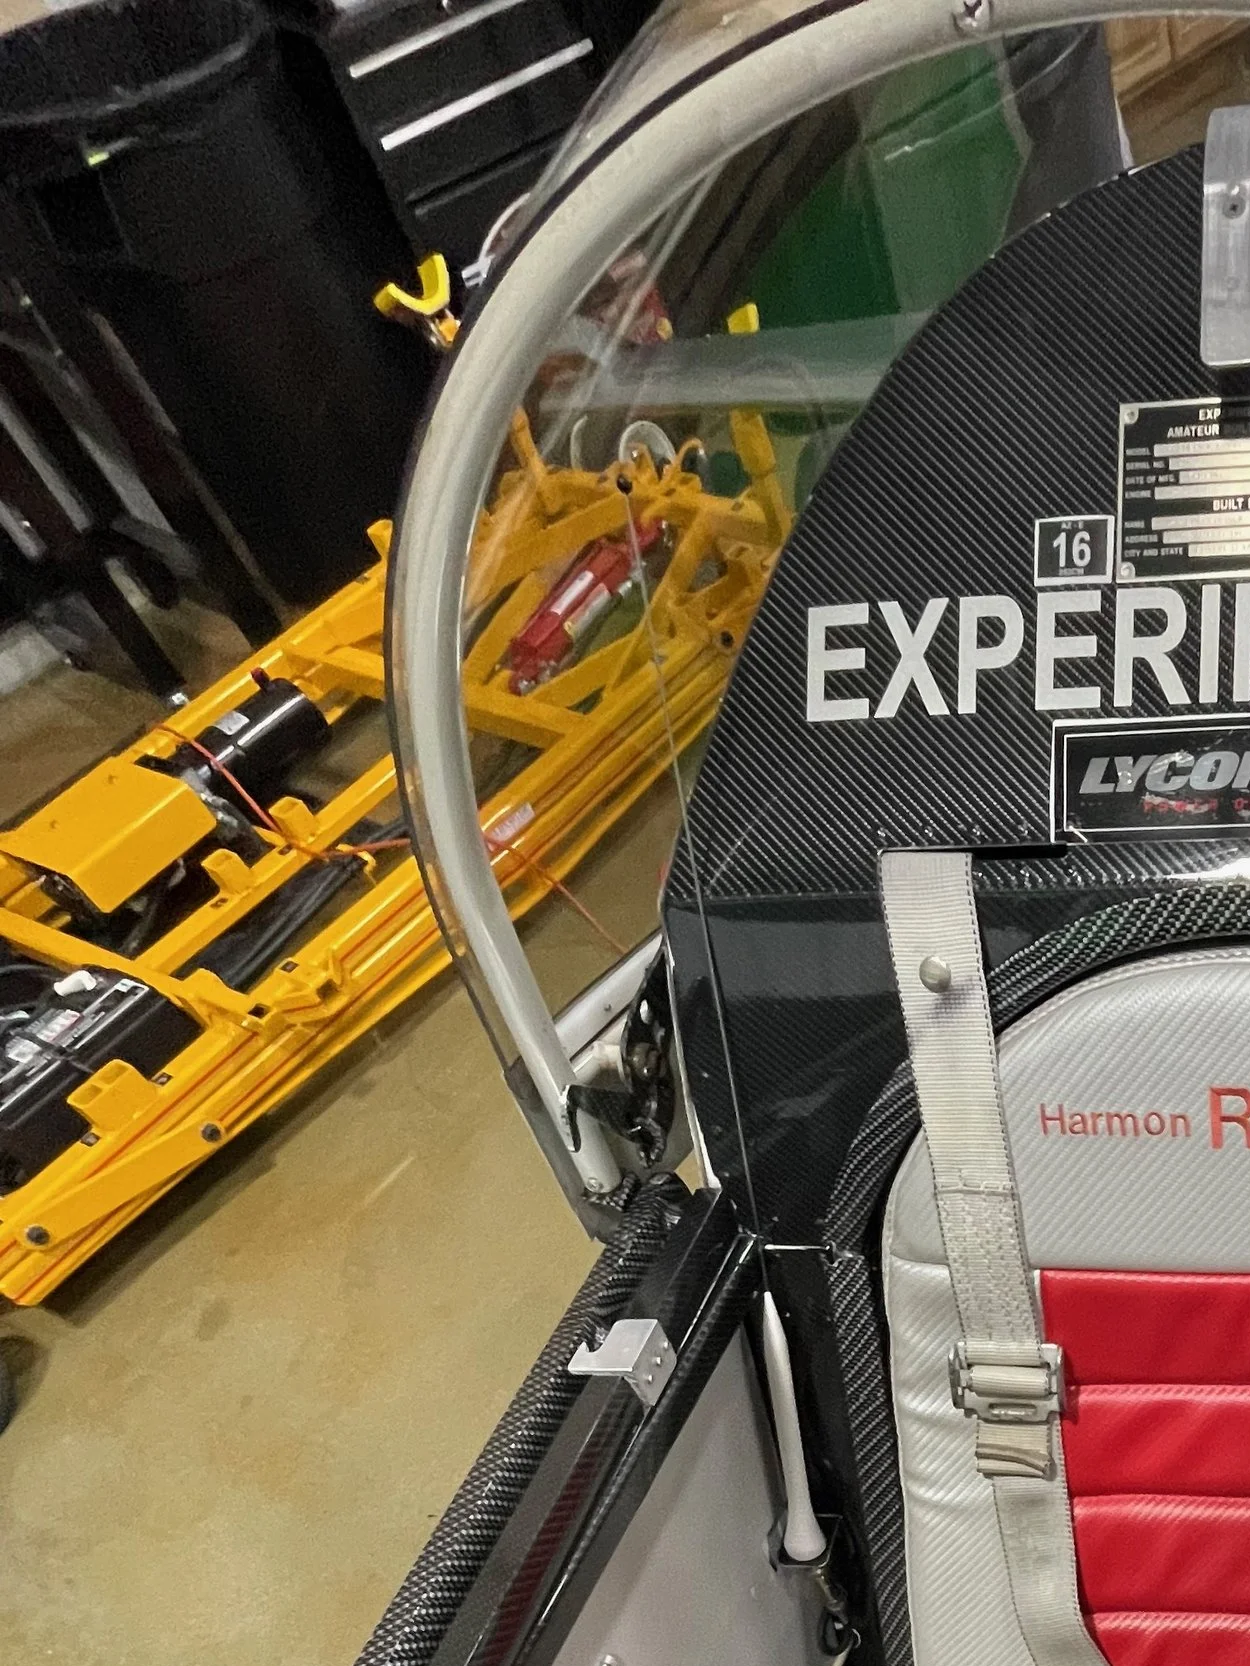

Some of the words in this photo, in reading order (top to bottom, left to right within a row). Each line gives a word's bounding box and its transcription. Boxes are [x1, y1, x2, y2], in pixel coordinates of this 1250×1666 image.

[1167, 423, 1220, 438] AMATEUR
[1213, 498, 1243, 511] BUILT
[1052, 530, 1092, 568] 16
[1142, 547, 1159, 557] AND
[1160, 545, 1184, 556] STATE
[1039, 1102, 1192, 1138] Harmon
